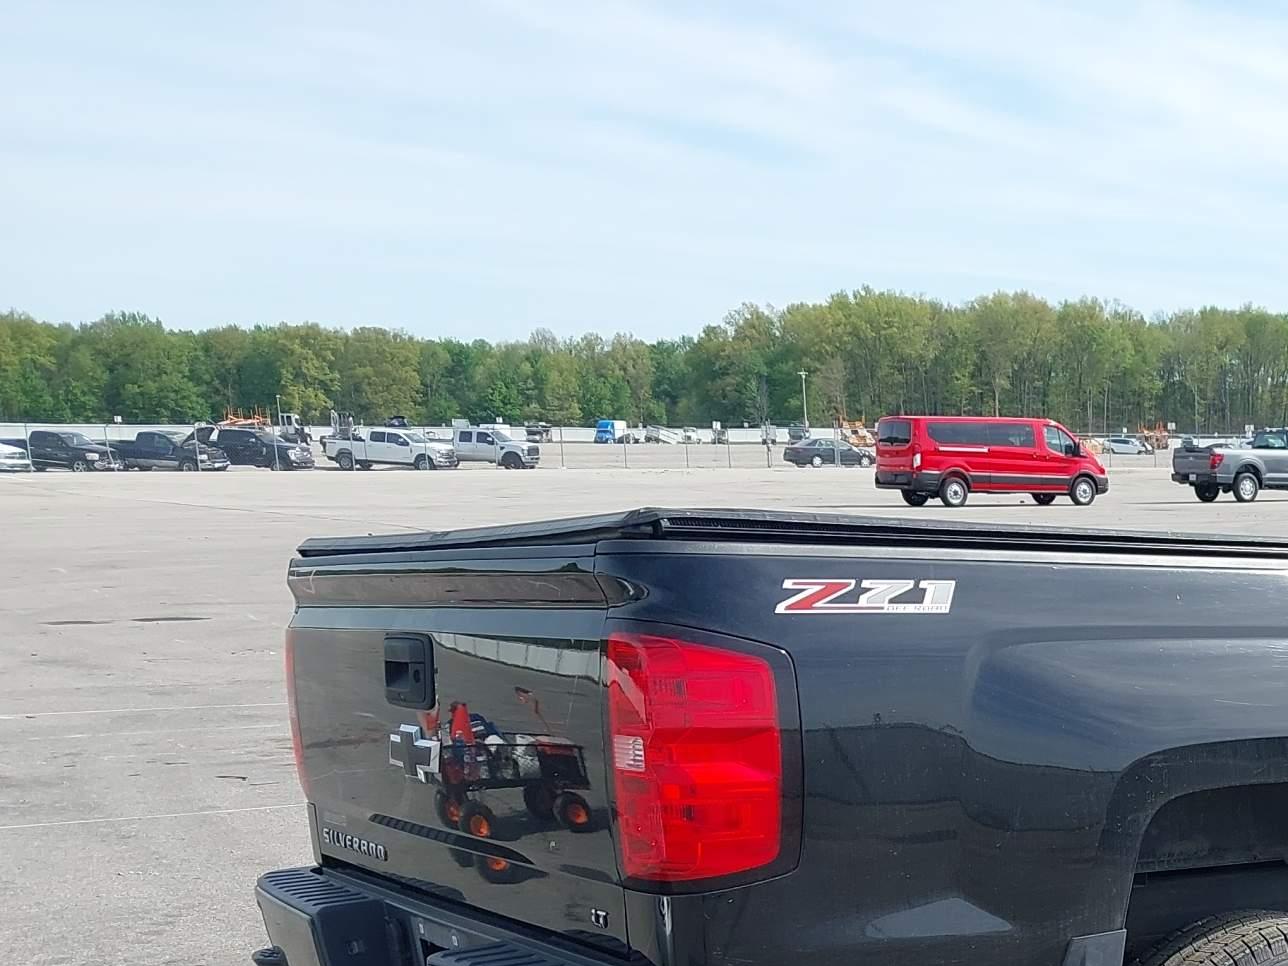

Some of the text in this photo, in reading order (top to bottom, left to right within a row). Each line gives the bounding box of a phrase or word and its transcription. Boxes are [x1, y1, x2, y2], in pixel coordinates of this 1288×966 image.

[774, 579, 956, 614] Z71
[322, 828, 387, 861] SILVERADO
[591, 909, 607, 929] LT
